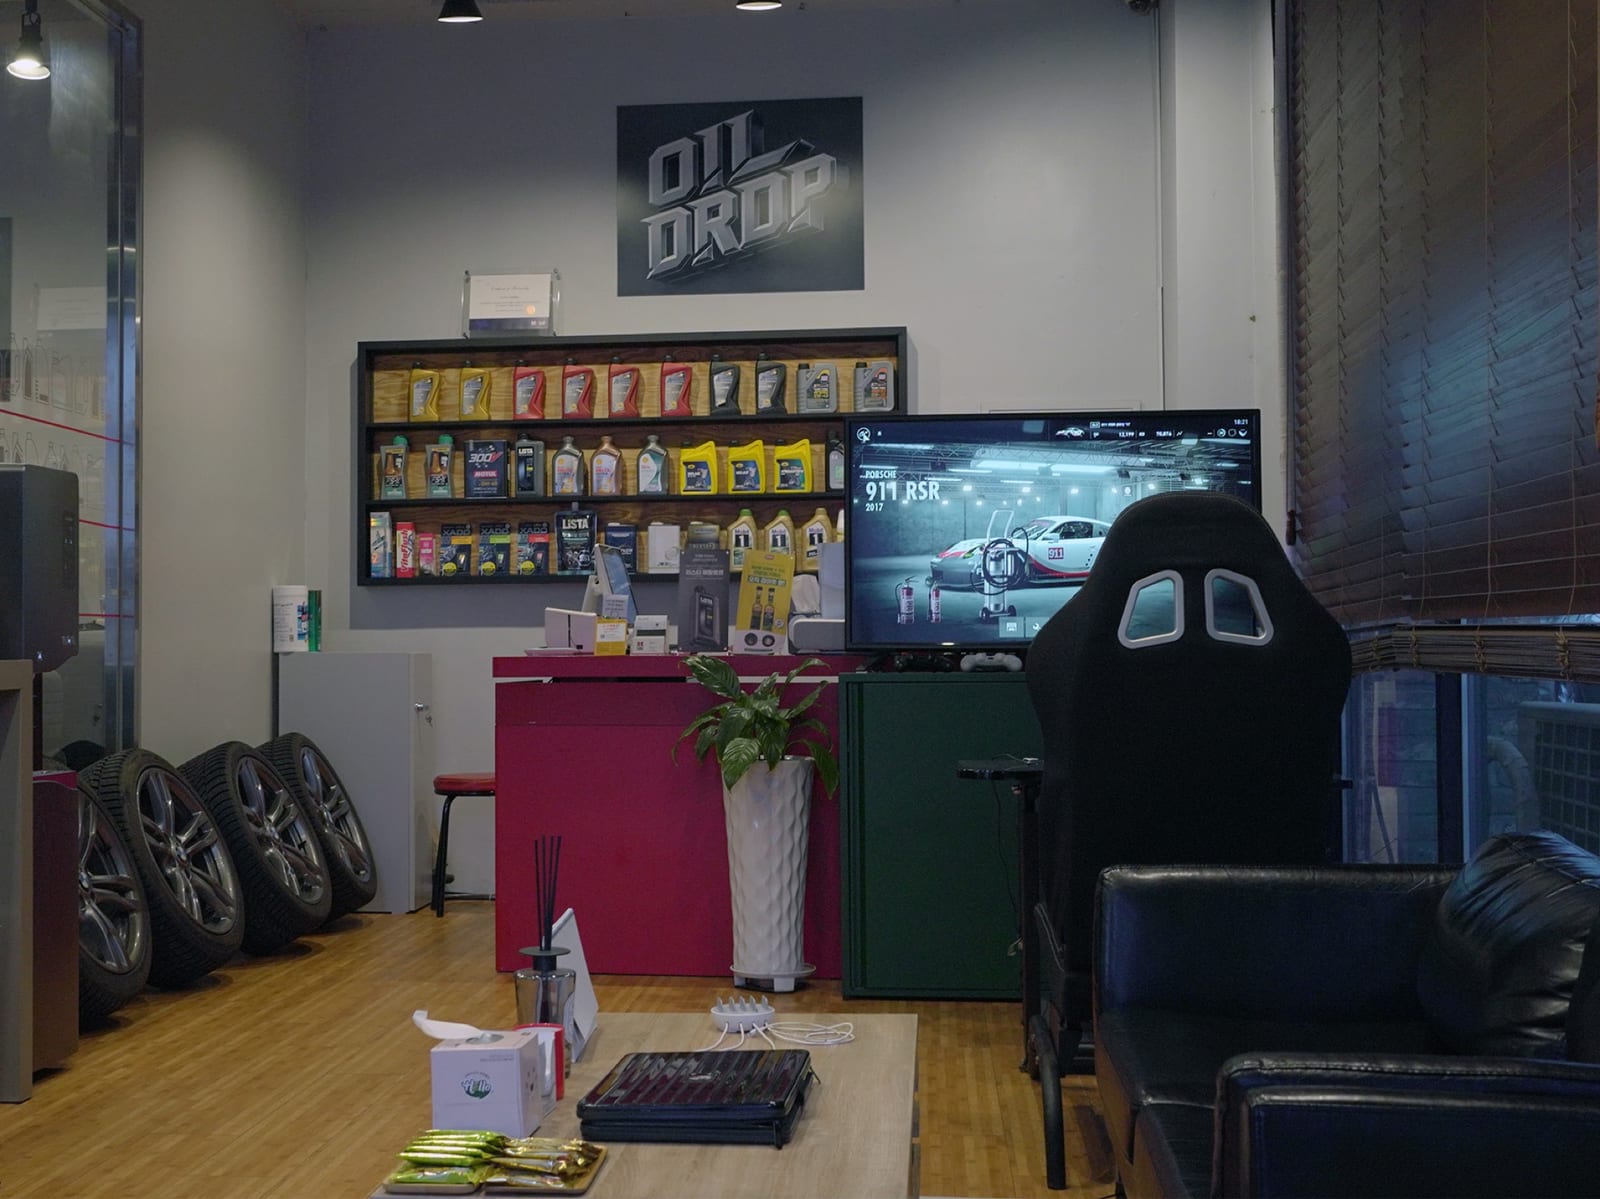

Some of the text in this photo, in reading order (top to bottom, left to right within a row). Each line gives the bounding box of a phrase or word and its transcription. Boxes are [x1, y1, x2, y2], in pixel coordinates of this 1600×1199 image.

[648, 109, 815, 206] OIL
[640, 153, 837, 280] DROP
[468, 451, 504, 463] 300V
[865, 470, 897, 479] PORSCHE
[865, 481, 940, 501] 911 RSR
[865, 502, 884, 512] 2017
[519, 526, 548, 534] XADO
[562, 518, 589, 530] LISTA
[442, 528, 471, 536] XADO
[480, 527, 509, 535] XADO
[1048, 547, 1063, 559] 911
